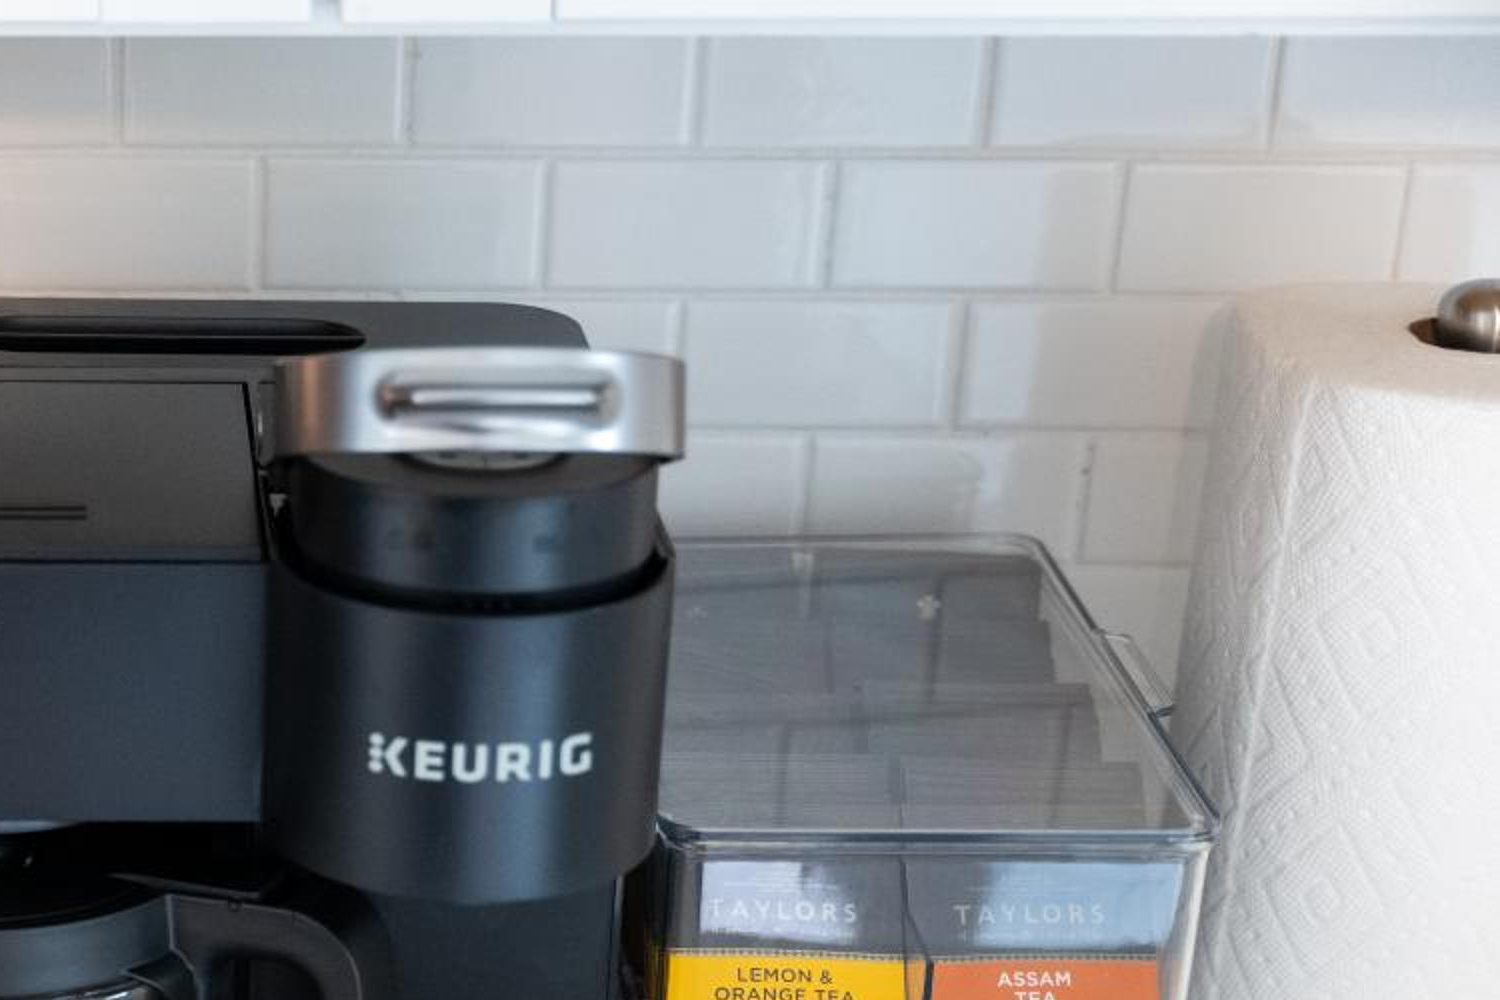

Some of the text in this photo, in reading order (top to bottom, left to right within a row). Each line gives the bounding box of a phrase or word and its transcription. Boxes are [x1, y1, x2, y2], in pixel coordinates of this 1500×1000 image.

[368, 731, 594, 784] KEURIG
[708, 899, 858, 924] TAYLORS
[953, 903, 1107, 926] TAYLORS
[737, 967, 833, 985] LEMON &
[997, 971, 1072, 988] ASSAM
